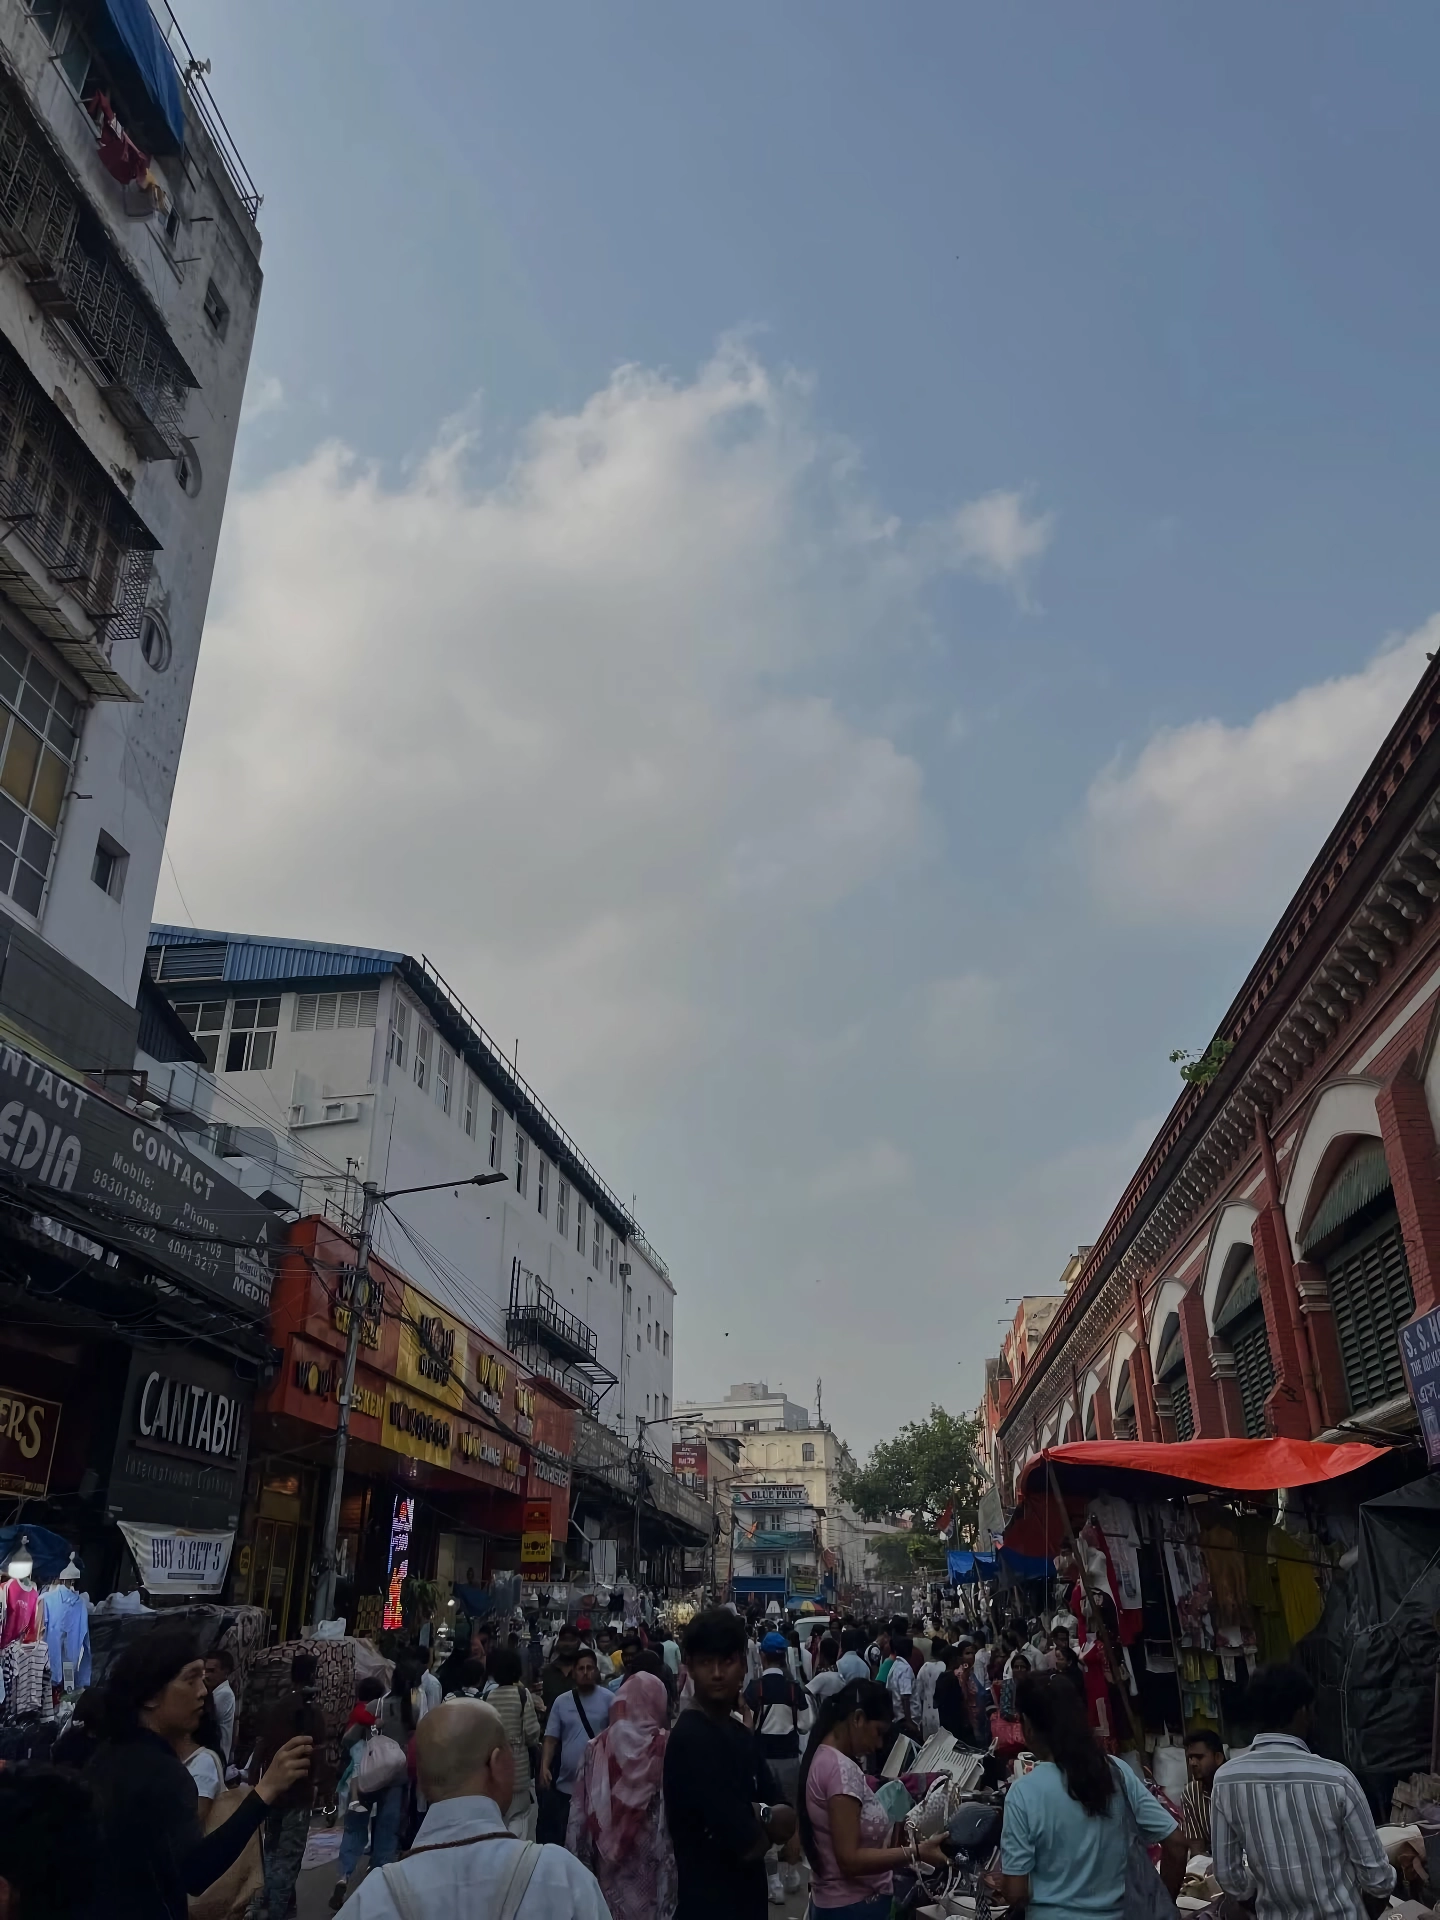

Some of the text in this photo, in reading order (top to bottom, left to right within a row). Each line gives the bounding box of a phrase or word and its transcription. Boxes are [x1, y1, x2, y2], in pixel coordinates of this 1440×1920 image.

[0, 1043, 88, 1118] NTACT
[112, 1152, 155, 1190] Mobile:
[133, 1127, 215, 1201] CONTACT
[92, 1168, 162, 1220] 9830156349
[183, 1202, 219, 1235] Phone:
[232, 1276, 270, 1308] MEDIA
[751, 1490, 803, 1499] BLUE PRINT
[152, 1539, 176, 1569] BUY
[178, 1541, 186, 1569] 3
[188, 1541, 212, 1570] GET
